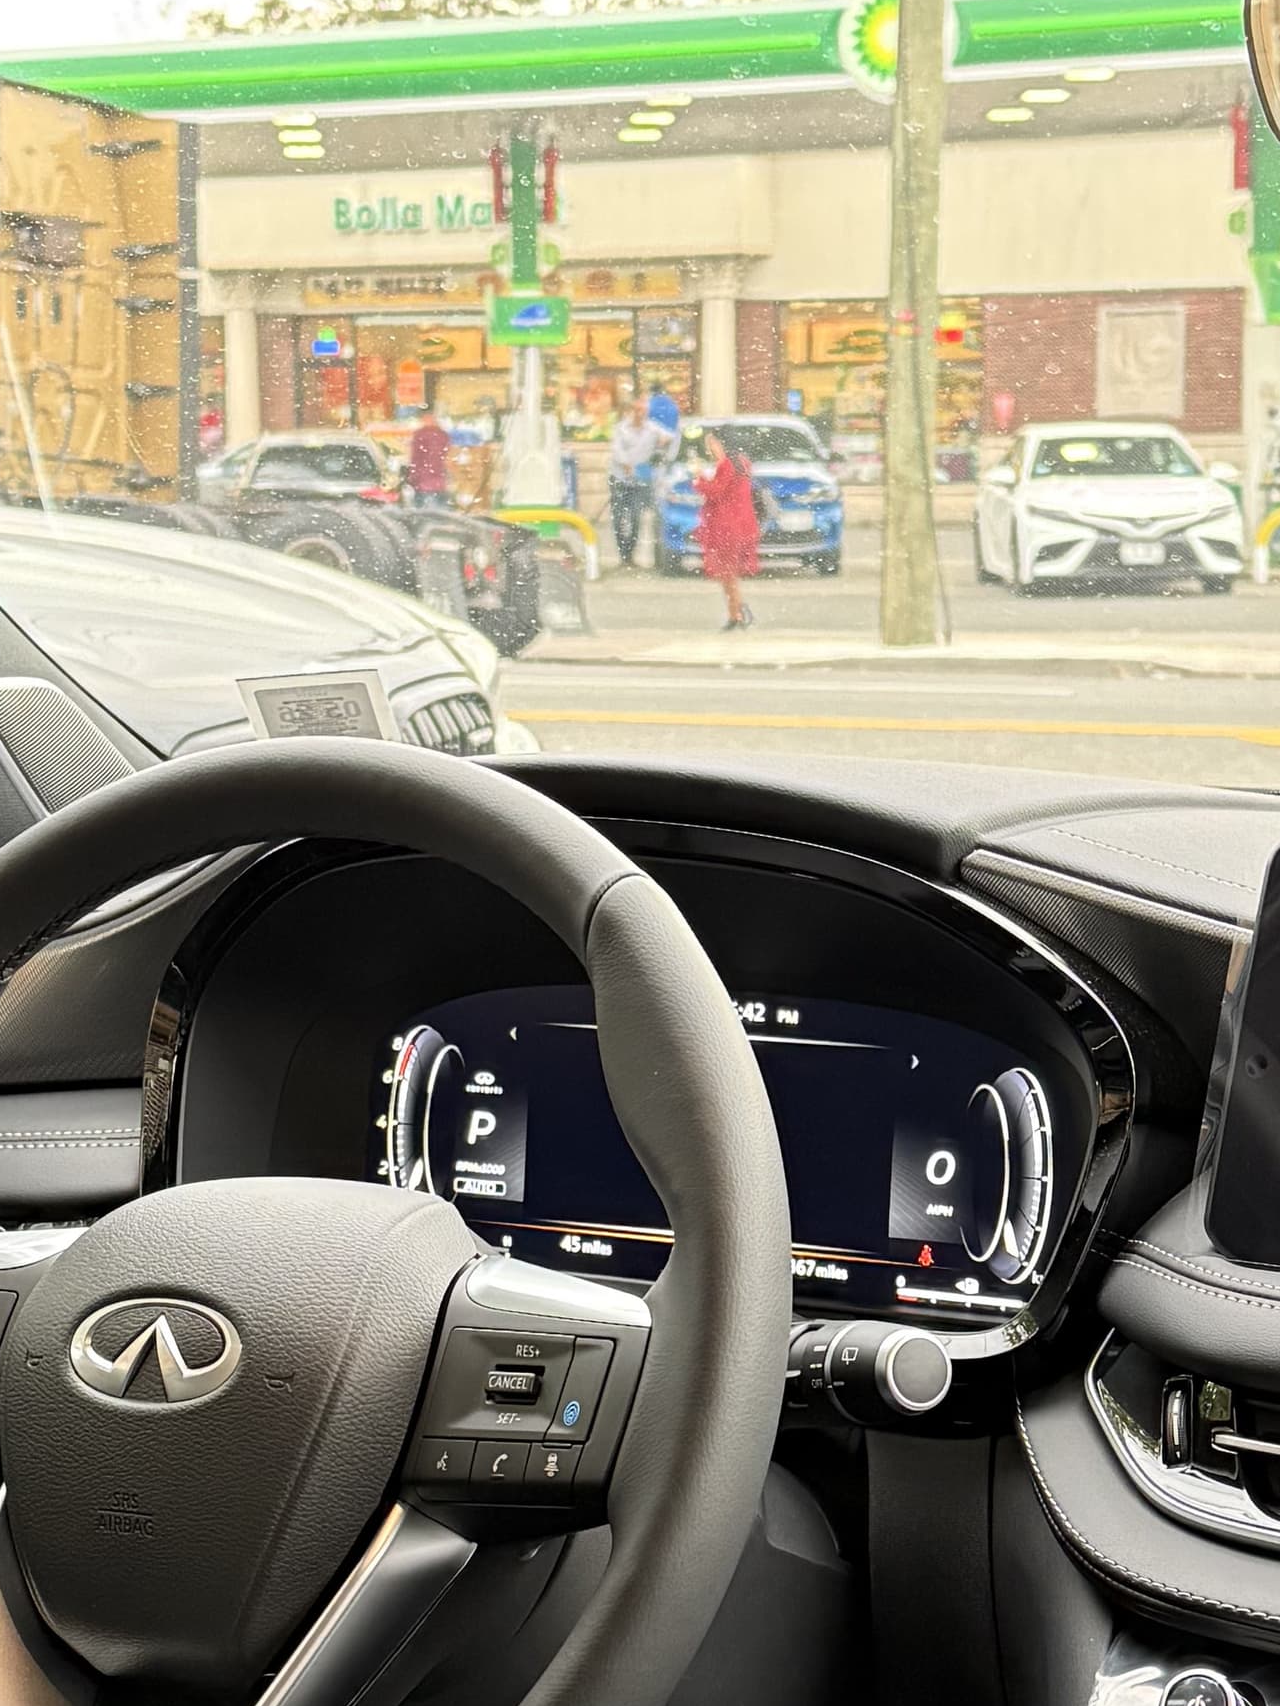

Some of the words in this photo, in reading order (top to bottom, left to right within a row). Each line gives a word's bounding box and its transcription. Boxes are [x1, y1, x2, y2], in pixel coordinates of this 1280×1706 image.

[332, 197, 423, 231] Bolla
[777, 1009, 800, 1025] PM
[392, 1036, 403, 1051] 8
[382, 1070, 393, 1084] 6
[376, 1114, 388, 1129] 4
[467, 1110, 496, 1145] P
[377, 1160, 389, 1175] 2
[925, 1150, 956, 1185] 0
[464, 1179, 496, 1193] AUTO
[926, 1202, 954, 1219] MPH
[560, 1234, 581, 1255] 45
[583, 1239, 614, 1257] miles
[816, 1261, 848, 1282] miles
[515, 1344, 541, 1357] RES+
[488, 1375, 529, 1390] CANCEL
[496, 1413, 521, 1424] SET-
